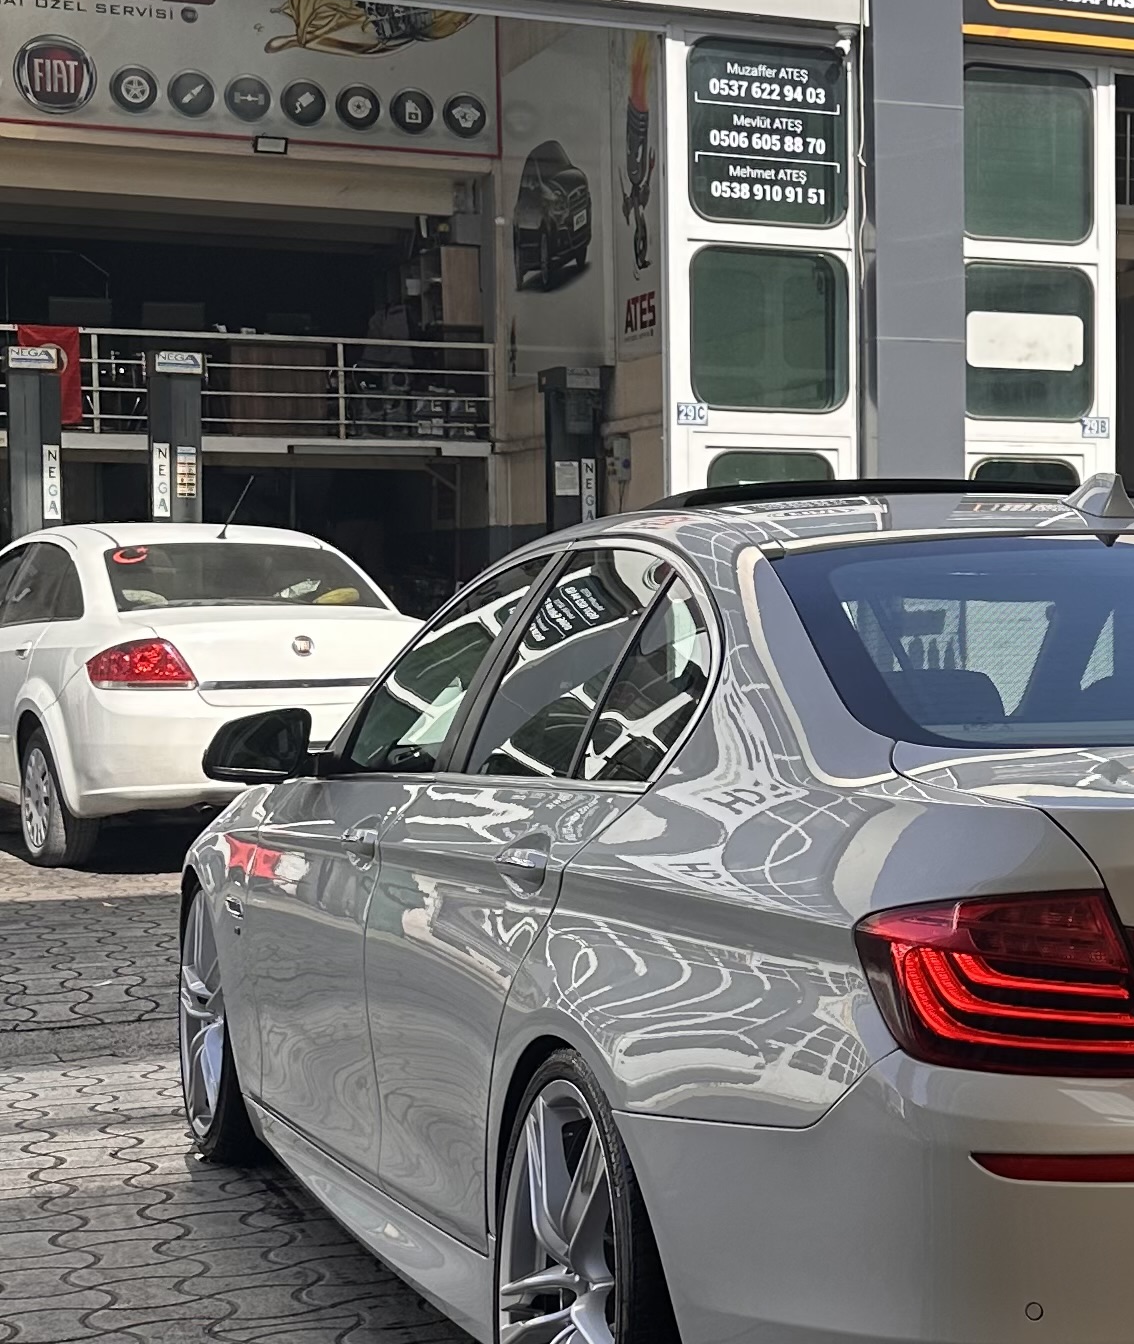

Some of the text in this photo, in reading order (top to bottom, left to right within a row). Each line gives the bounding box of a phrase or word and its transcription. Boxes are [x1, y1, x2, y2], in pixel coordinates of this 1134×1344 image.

[95, 2, 174, 20] SERVİSİ
[33, 58, 78, 94] FIAT
[726, 62, 809, 84] Muzaffer ATEŞ
[709, 78, 826, 104] 0537 622 94 03
[772, 117, 803, 134] ATEŞ
[709, 130, 826, 155] 0506 605 88 70
[728, 165, 808, 185] Mehmet ATEŞ
[710, 181, 826, 206] 0538 910 91 51
[10, 347, 55, 361] NEGA
[157, 352, 200, 365] NEGA
